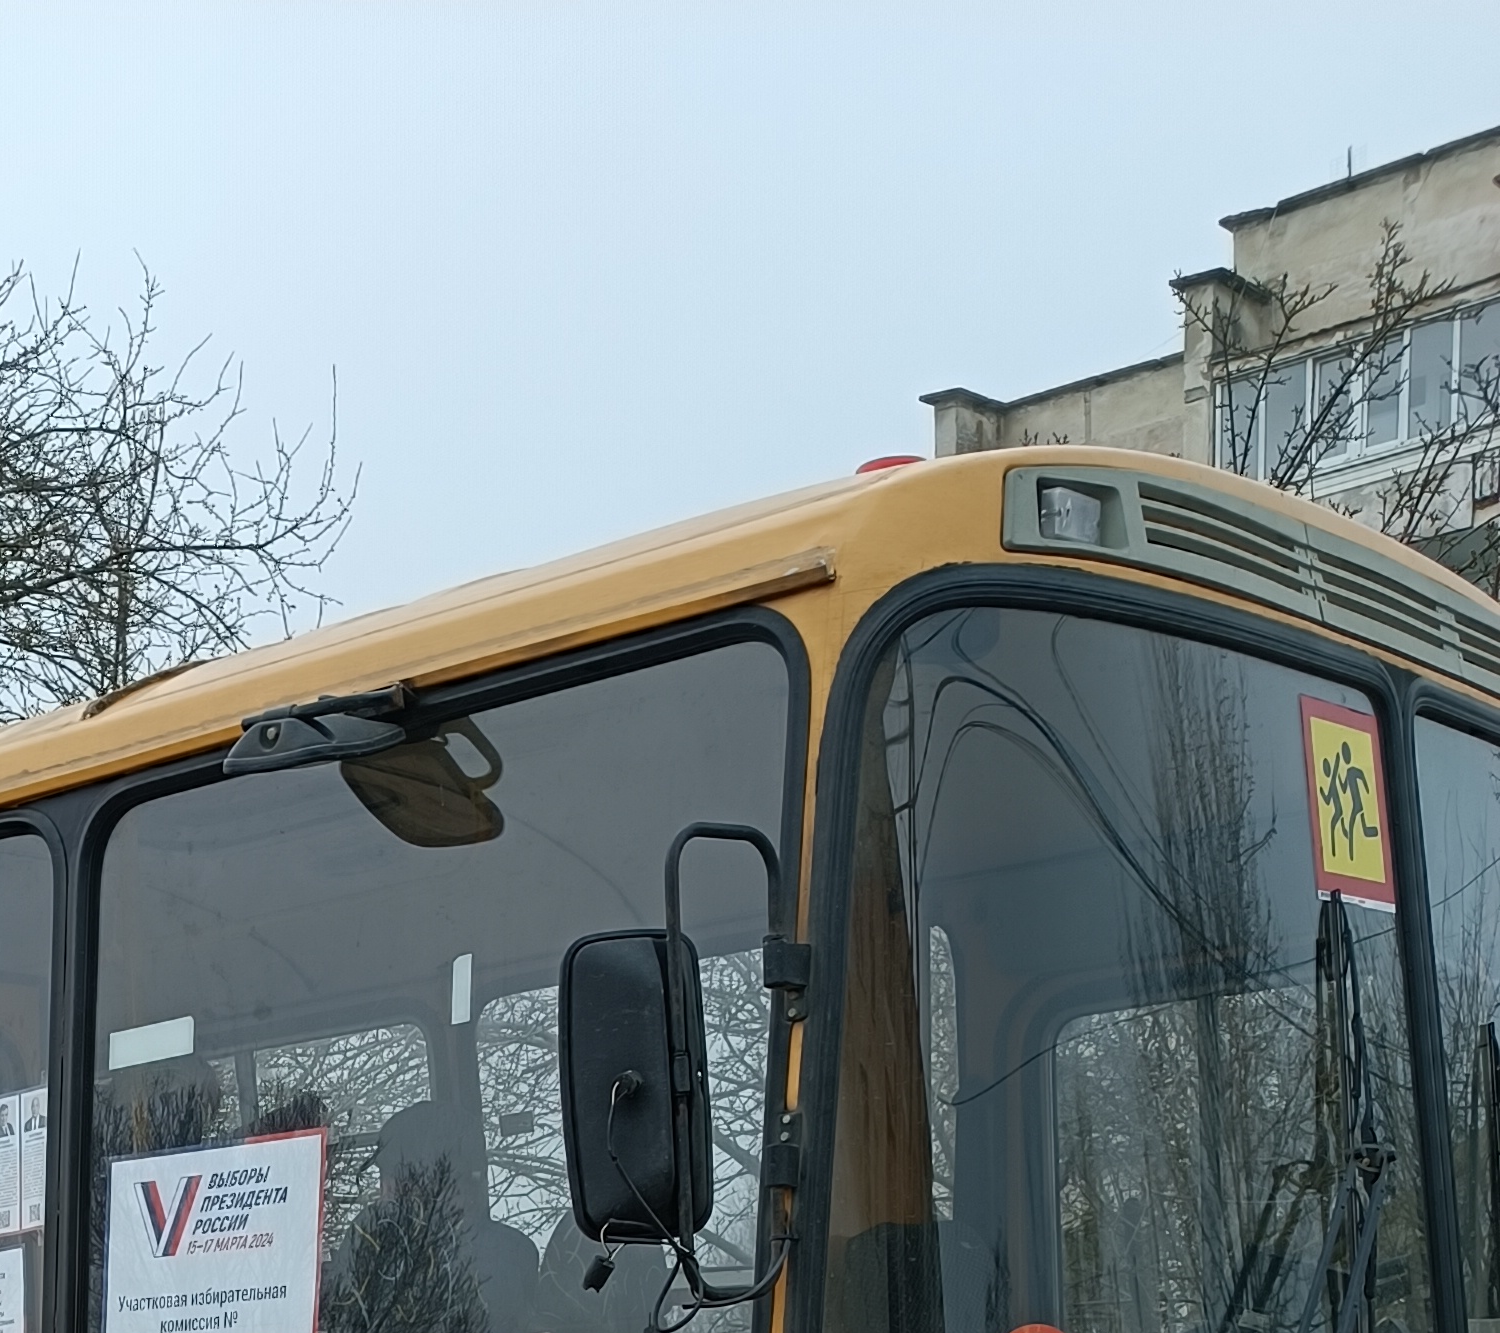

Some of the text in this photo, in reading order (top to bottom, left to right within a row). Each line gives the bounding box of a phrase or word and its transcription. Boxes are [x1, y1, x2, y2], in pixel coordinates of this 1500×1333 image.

[208, 1166, 270, 1189] ВЫБОРЫ
[200, 1186, 288, 1212] ПРЕЗИДЕНТА
[192, 1214, 249, 1235] РОССИИ
[213, 1235, 247, 1253] МАРТА
[248, 1232, 274, 1250] 2024
[118, 1284, 288, 1312] Участковая избирательная
[160, 1311, 238, 1333] комиссия №
